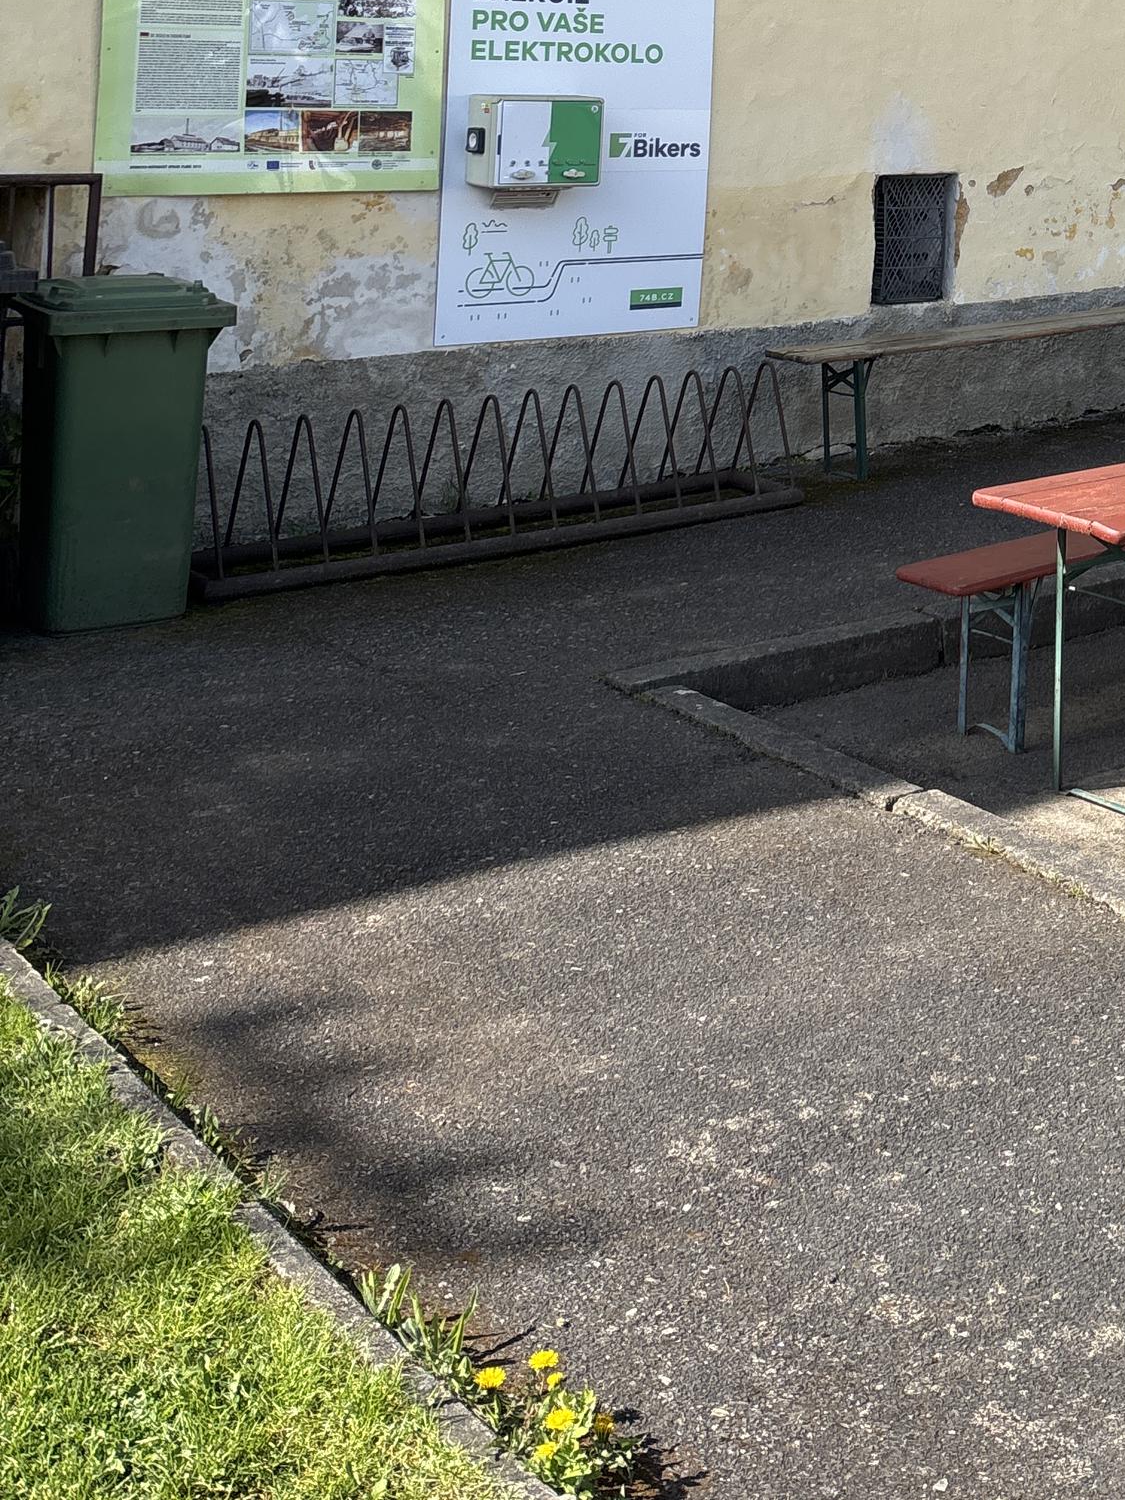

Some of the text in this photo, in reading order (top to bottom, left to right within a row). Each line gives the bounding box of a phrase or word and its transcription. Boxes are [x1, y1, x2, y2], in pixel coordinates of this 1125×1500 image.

[472, 7, 605, 34] PRO VAŠE
[471, 39, 664, 64] ELEKTROKOLO
[633, 138, 701, 158] Bikers
